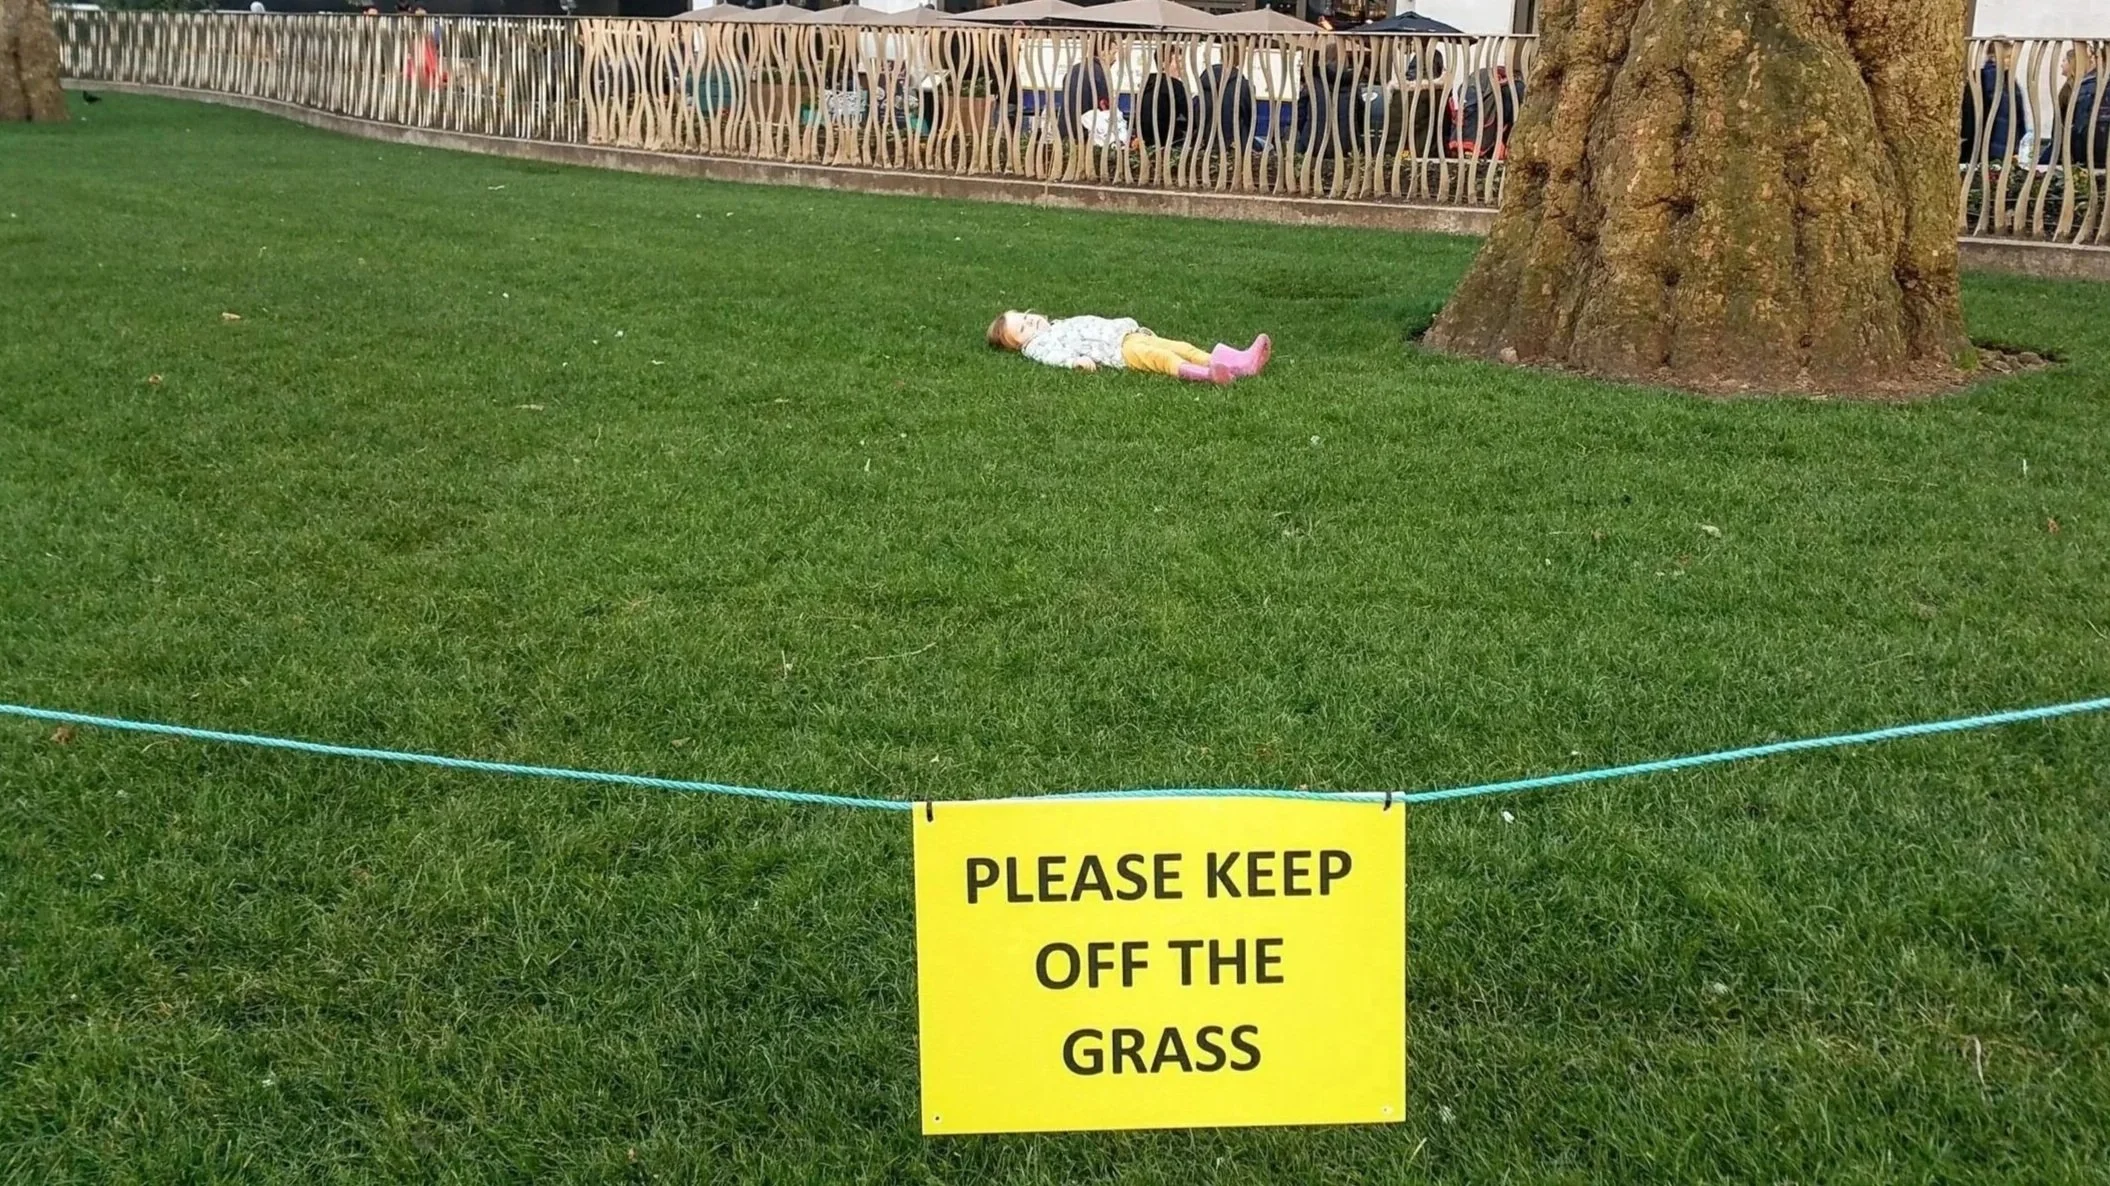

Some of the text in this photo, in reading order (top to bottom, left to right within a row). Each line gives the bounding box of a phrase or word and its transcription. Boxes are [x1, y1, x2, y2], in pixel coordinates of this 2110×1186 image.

[966, 850, 1352, 904] PLEASE KEEP
[1036, 938, 1284, 990] OFF THE
[1063, 1025, 1261, 1076] GRASS
